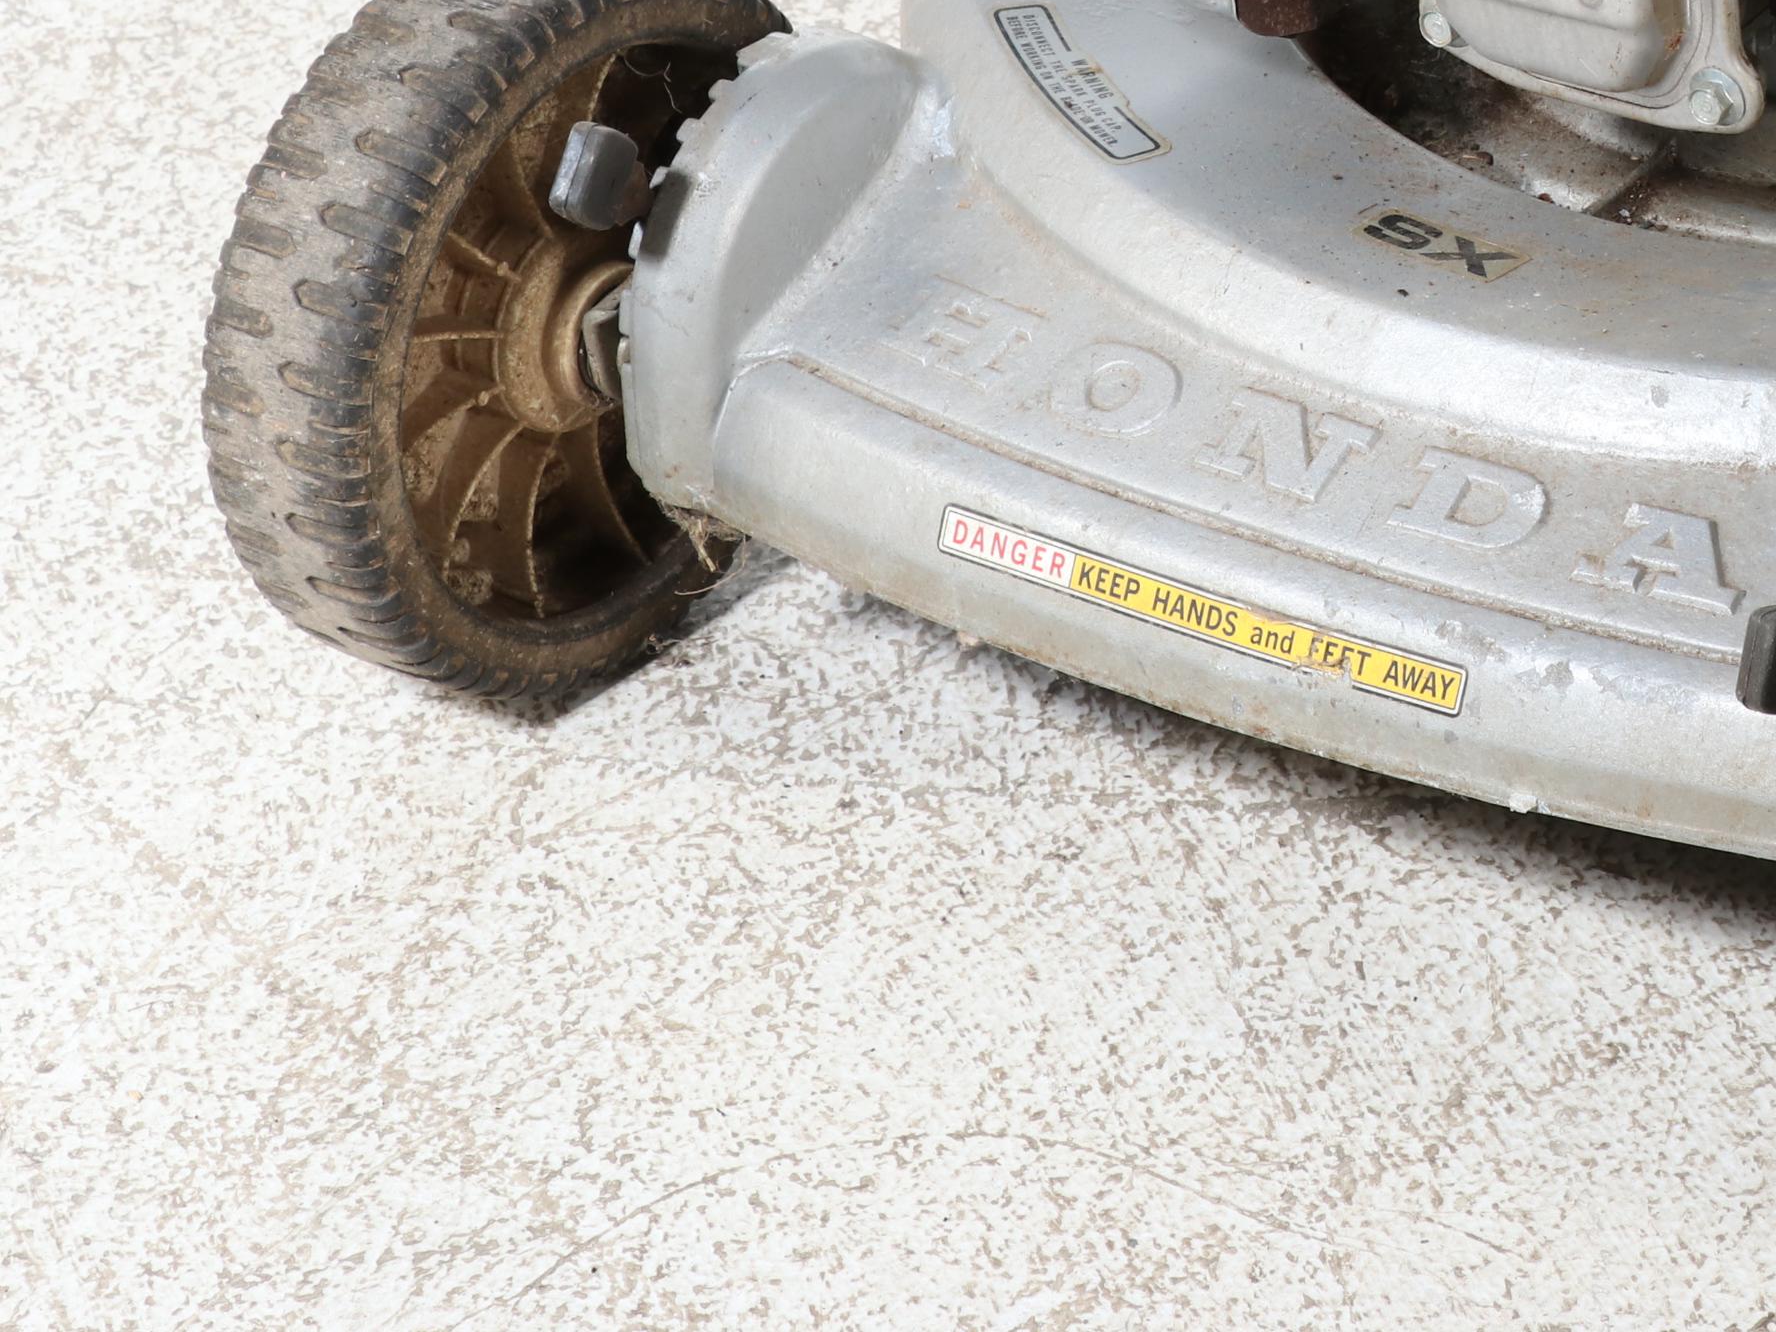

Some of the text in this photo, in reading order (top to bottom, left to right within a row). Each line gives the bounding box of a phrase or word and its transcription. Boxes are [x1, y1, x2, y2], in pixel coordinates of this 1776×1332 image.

[1006, 16, 1028, 39] BEFORE
[1021, 42, 1047, 69] WORKING
[1040, 71, 1054, 80] ON
[1048, 82, 1066, 94] THE
[1022, 14, 1056, 56] DISCONNECT
[1049, 60, 1068, 73] THE
[1061, 75, 1088, 96] SPARK
[1083, 99, 1106, 116] PLUG
[1071, 59, 1114, 99] WARNING
[1363, 214, 1520, 278] SX
[882, 274, 1747, 616] HONDA
[952, 518, 1455, 702] DANGER KEEP HANDS and FEET AWAY
